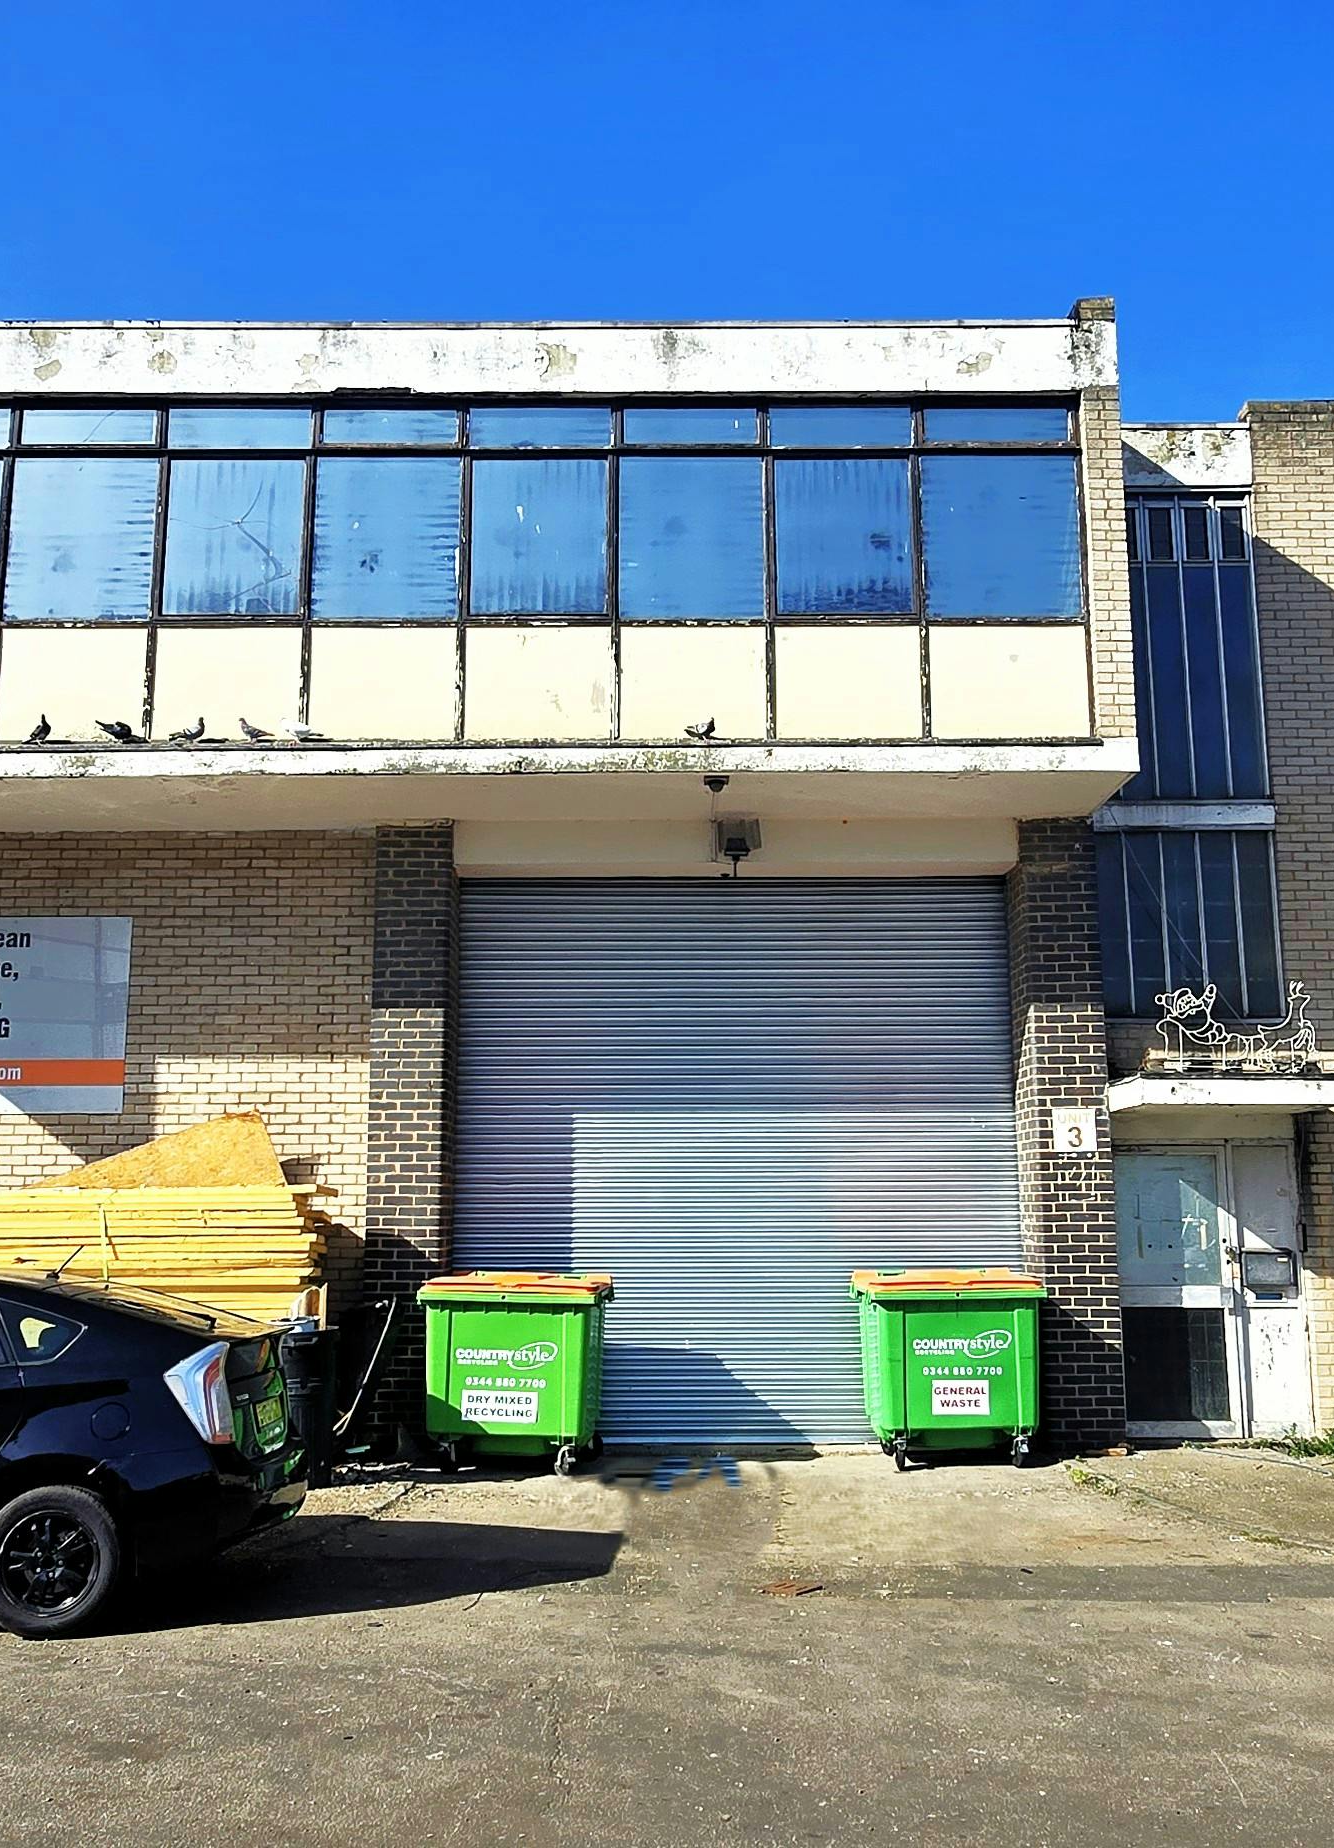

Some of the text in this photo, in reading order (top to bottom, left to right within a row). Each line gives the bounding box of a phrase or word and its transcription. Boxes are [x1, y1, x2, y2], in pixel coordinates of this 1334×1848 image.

[1057, 1112, 1090, 1124] UNIT
[1067, 1126, 1083, 1148] 3
[922, 1366, 949, 1375] 0344
[976, 1366, 1002, 1375] 7700
[465, 1376, 492, 1385] 0344
[518, 1378, 546, 1388] 7700
[934, 1386, 986, 1395] GENERAL
[467, 1395, 532, 1404] DRY MIXED
[940, 1399, 980, 1407] WASTE
[465, 1407, 532, 1417] RECYCLING
